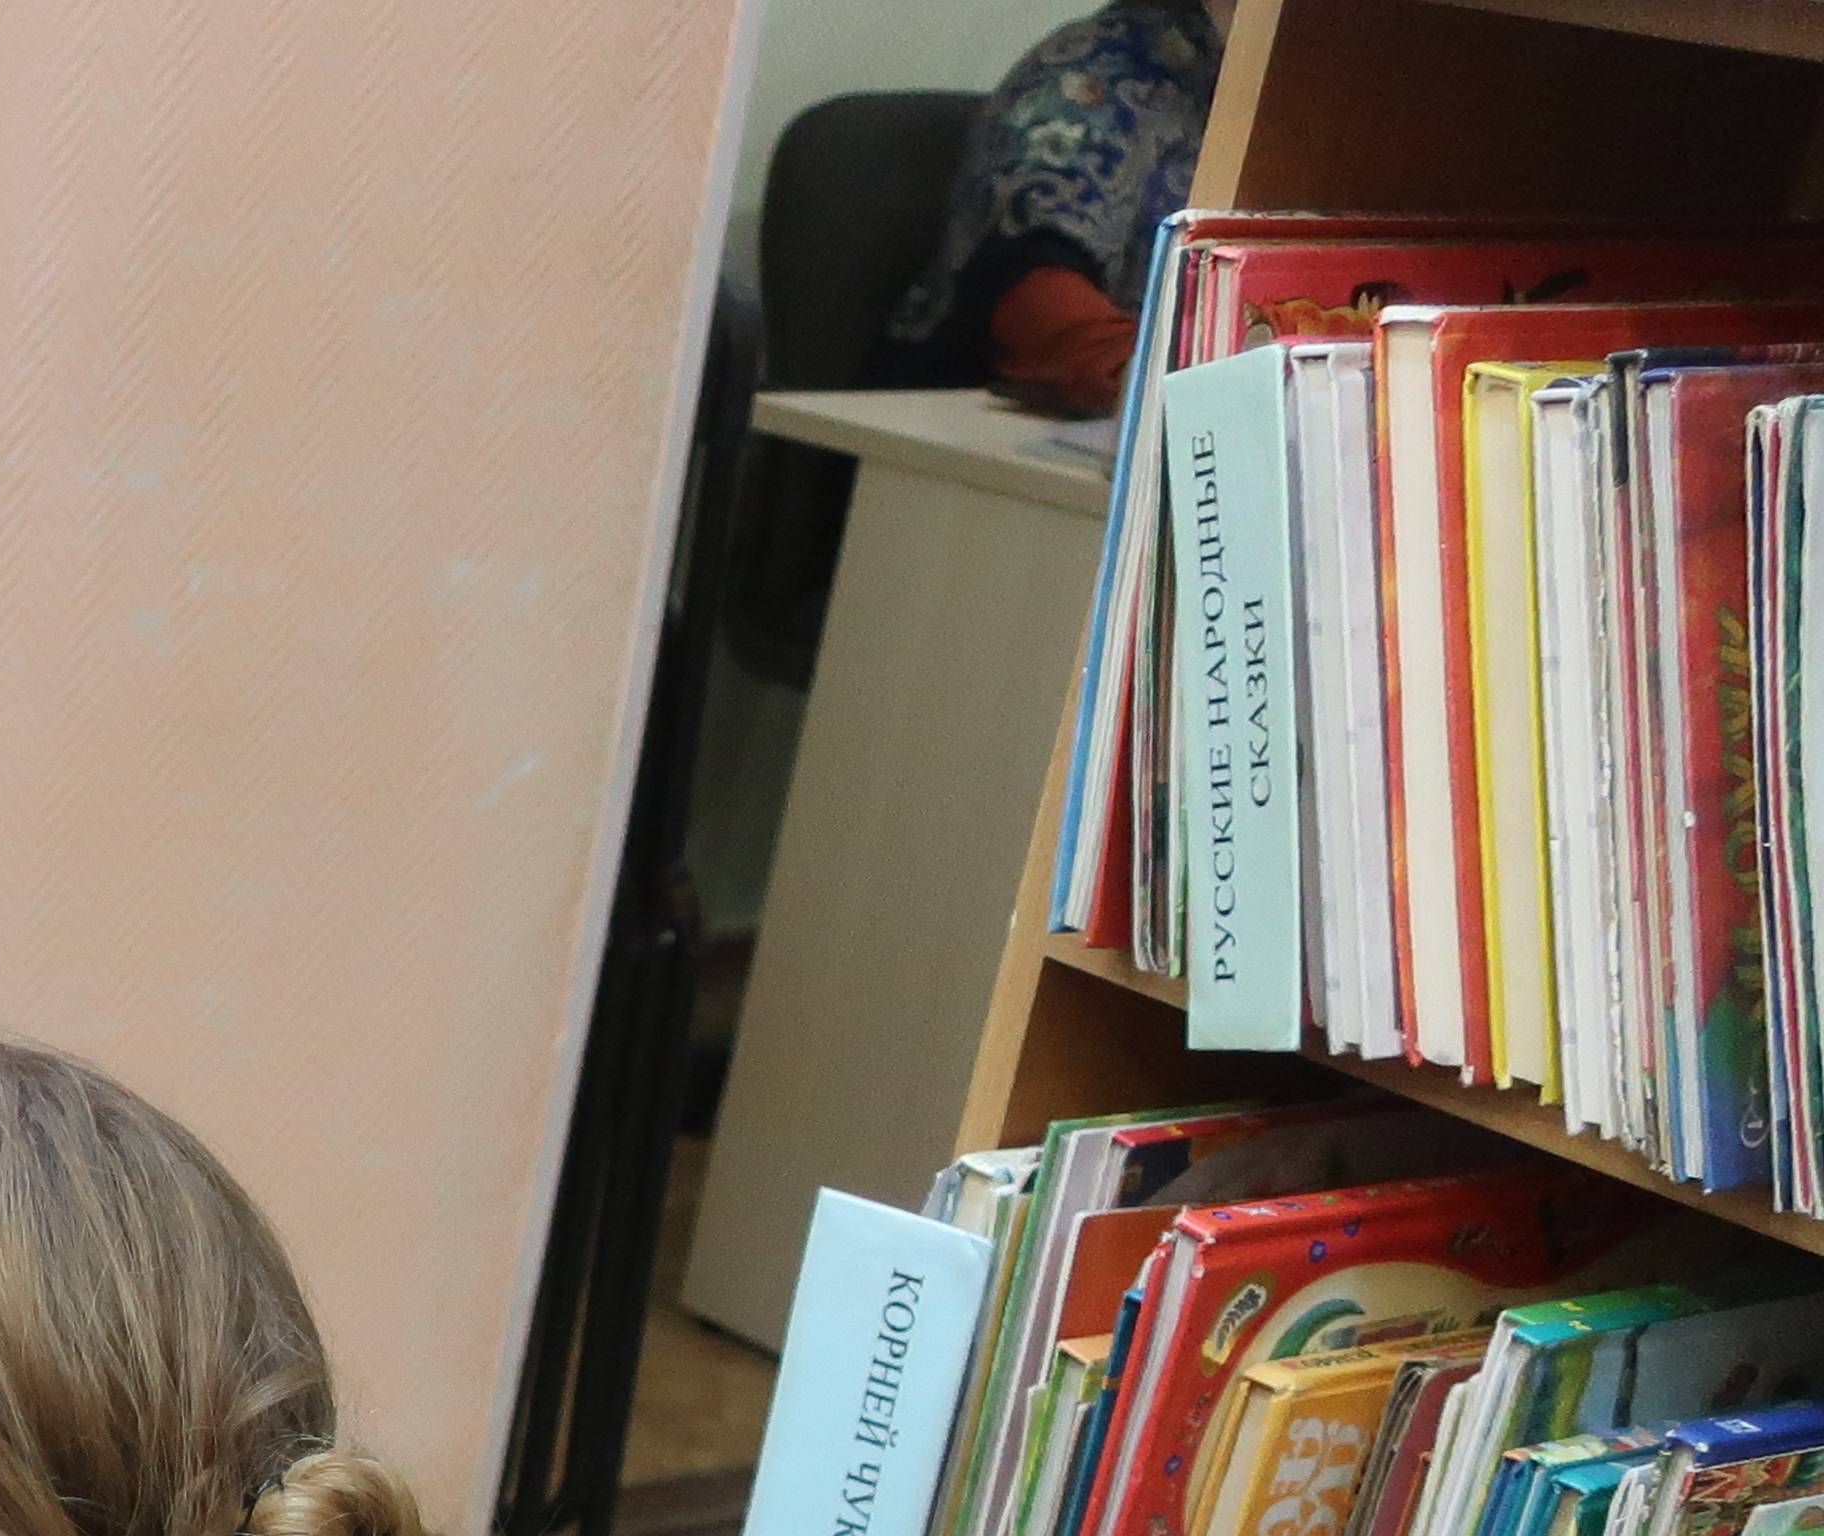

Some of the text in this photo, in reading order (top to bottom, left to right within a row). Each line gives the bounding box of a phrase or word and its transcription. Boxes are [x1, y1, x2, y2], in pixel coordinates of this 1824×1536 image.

[1191, 430, 1236, 983] РУССКИЕ НАРОДНЫЕ
[1243, 596, 1271, 808] СКАЗКИ
[854, 1267, 924, 1450] КОРНЕЙ
